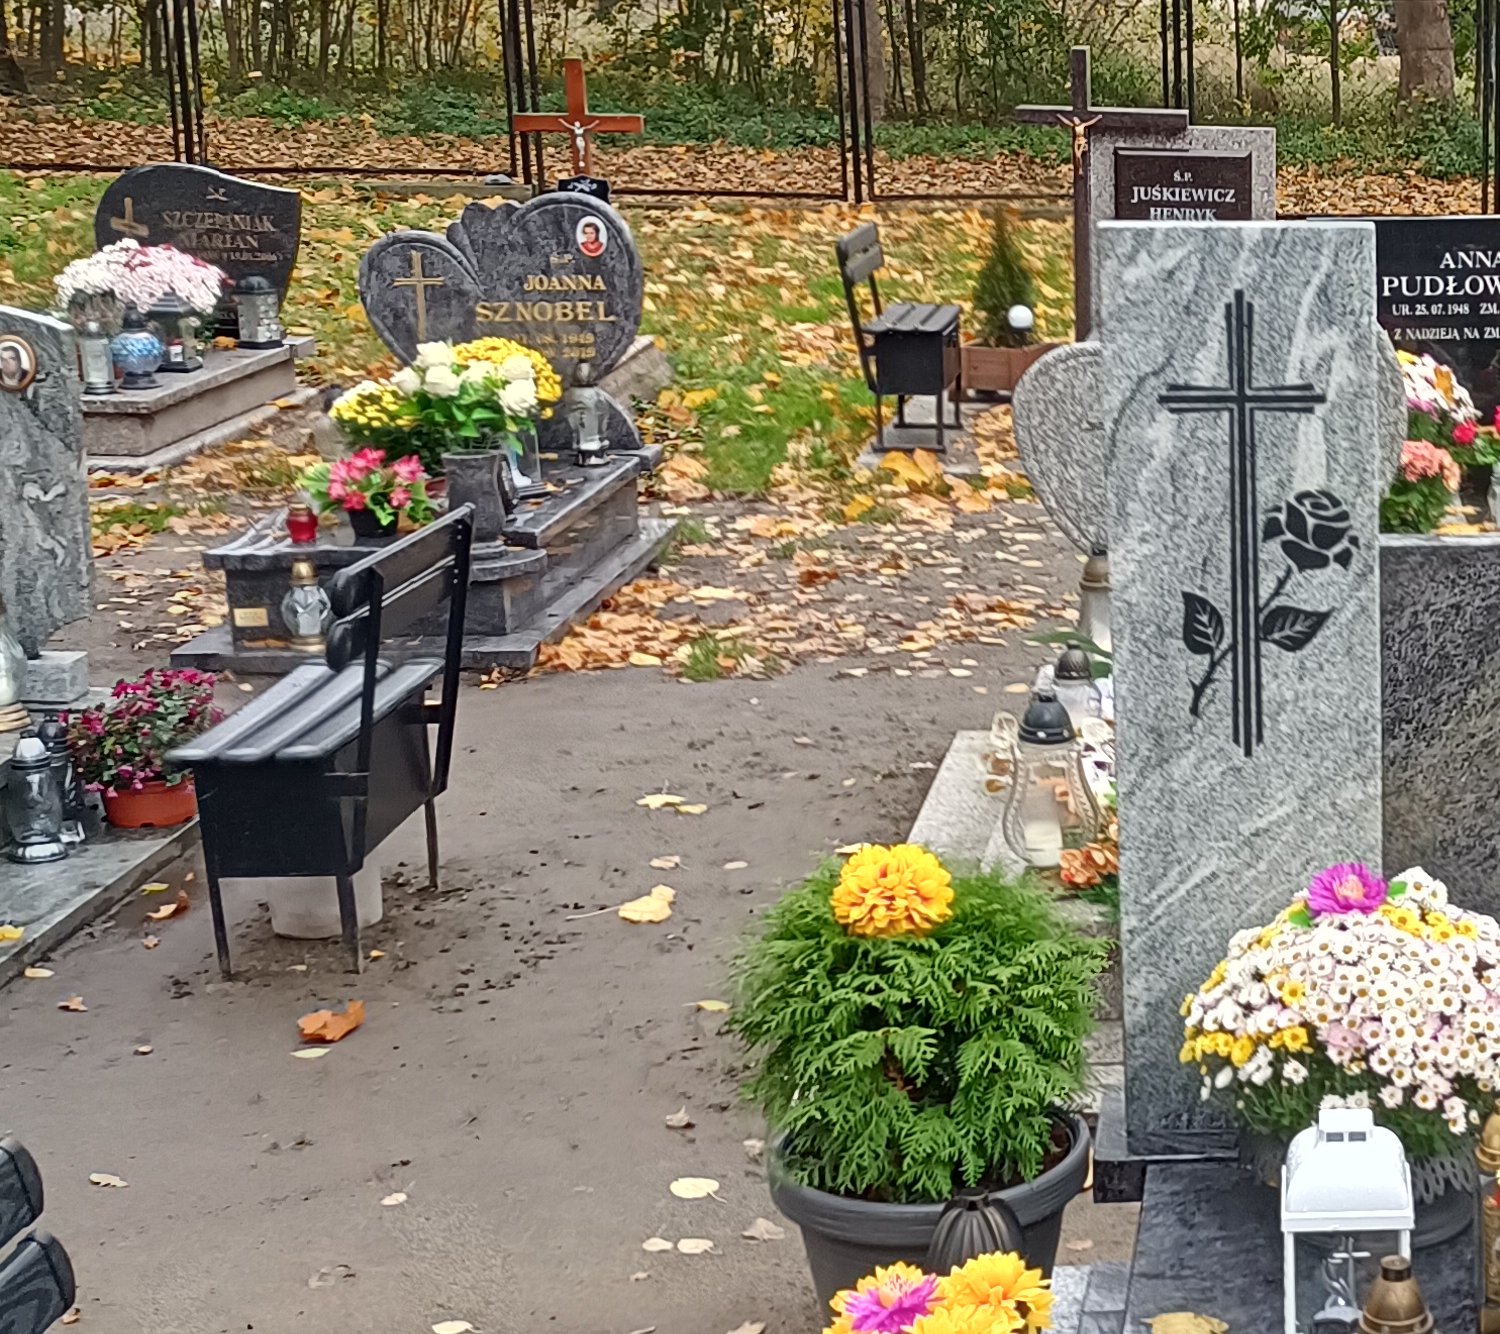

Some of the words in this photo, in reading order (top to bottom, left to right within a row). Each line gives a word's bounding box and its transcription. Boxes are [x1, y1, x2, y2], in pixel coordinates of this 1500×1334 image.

[1130, 183, 1236, 204] JUŚKIEWICZ
[1150, 207, 1217, 222] HENRYK
[523, 274, 608, 292] JOANNA
[475, 300, 618, 323] SZNOBEL
[1392, 303, 1413, 316] UR.
[1479, 302, 1500, 315] ZM.
[1394, 327, 1403, 340] Z
[1405, 327, 1461, 341] NADZIEJĄ
[1463, 327, 1481, 340] NA
